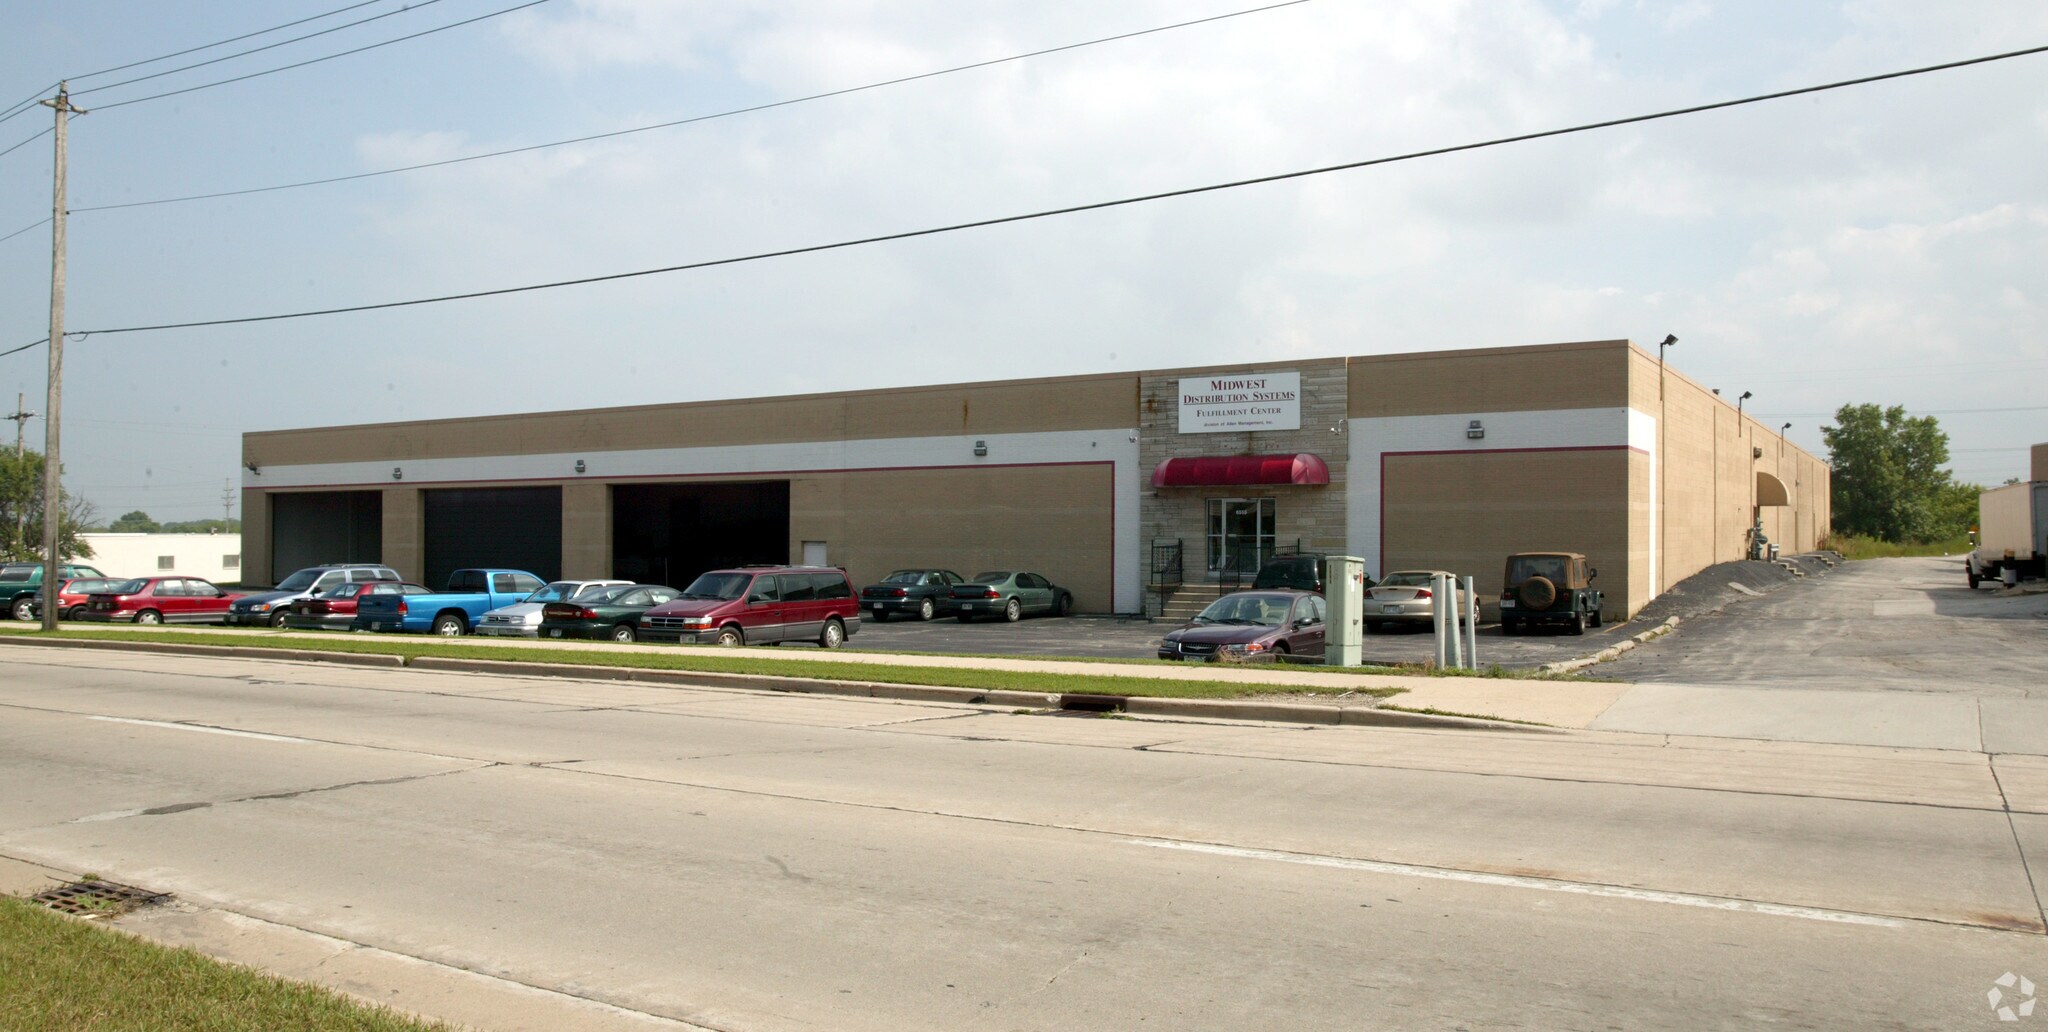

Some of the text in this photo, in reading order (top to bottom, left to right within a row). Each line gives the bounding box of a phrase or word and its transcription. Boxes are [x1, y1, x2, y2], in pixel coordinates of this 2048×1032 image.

[1211, 379, 1267, 391] MIDWEST
[1183, 391, 1295, 404] DISTRIBUTION SYSTEMS
[1196, 406, 1282, 417] FULFILLMENT CENTER
